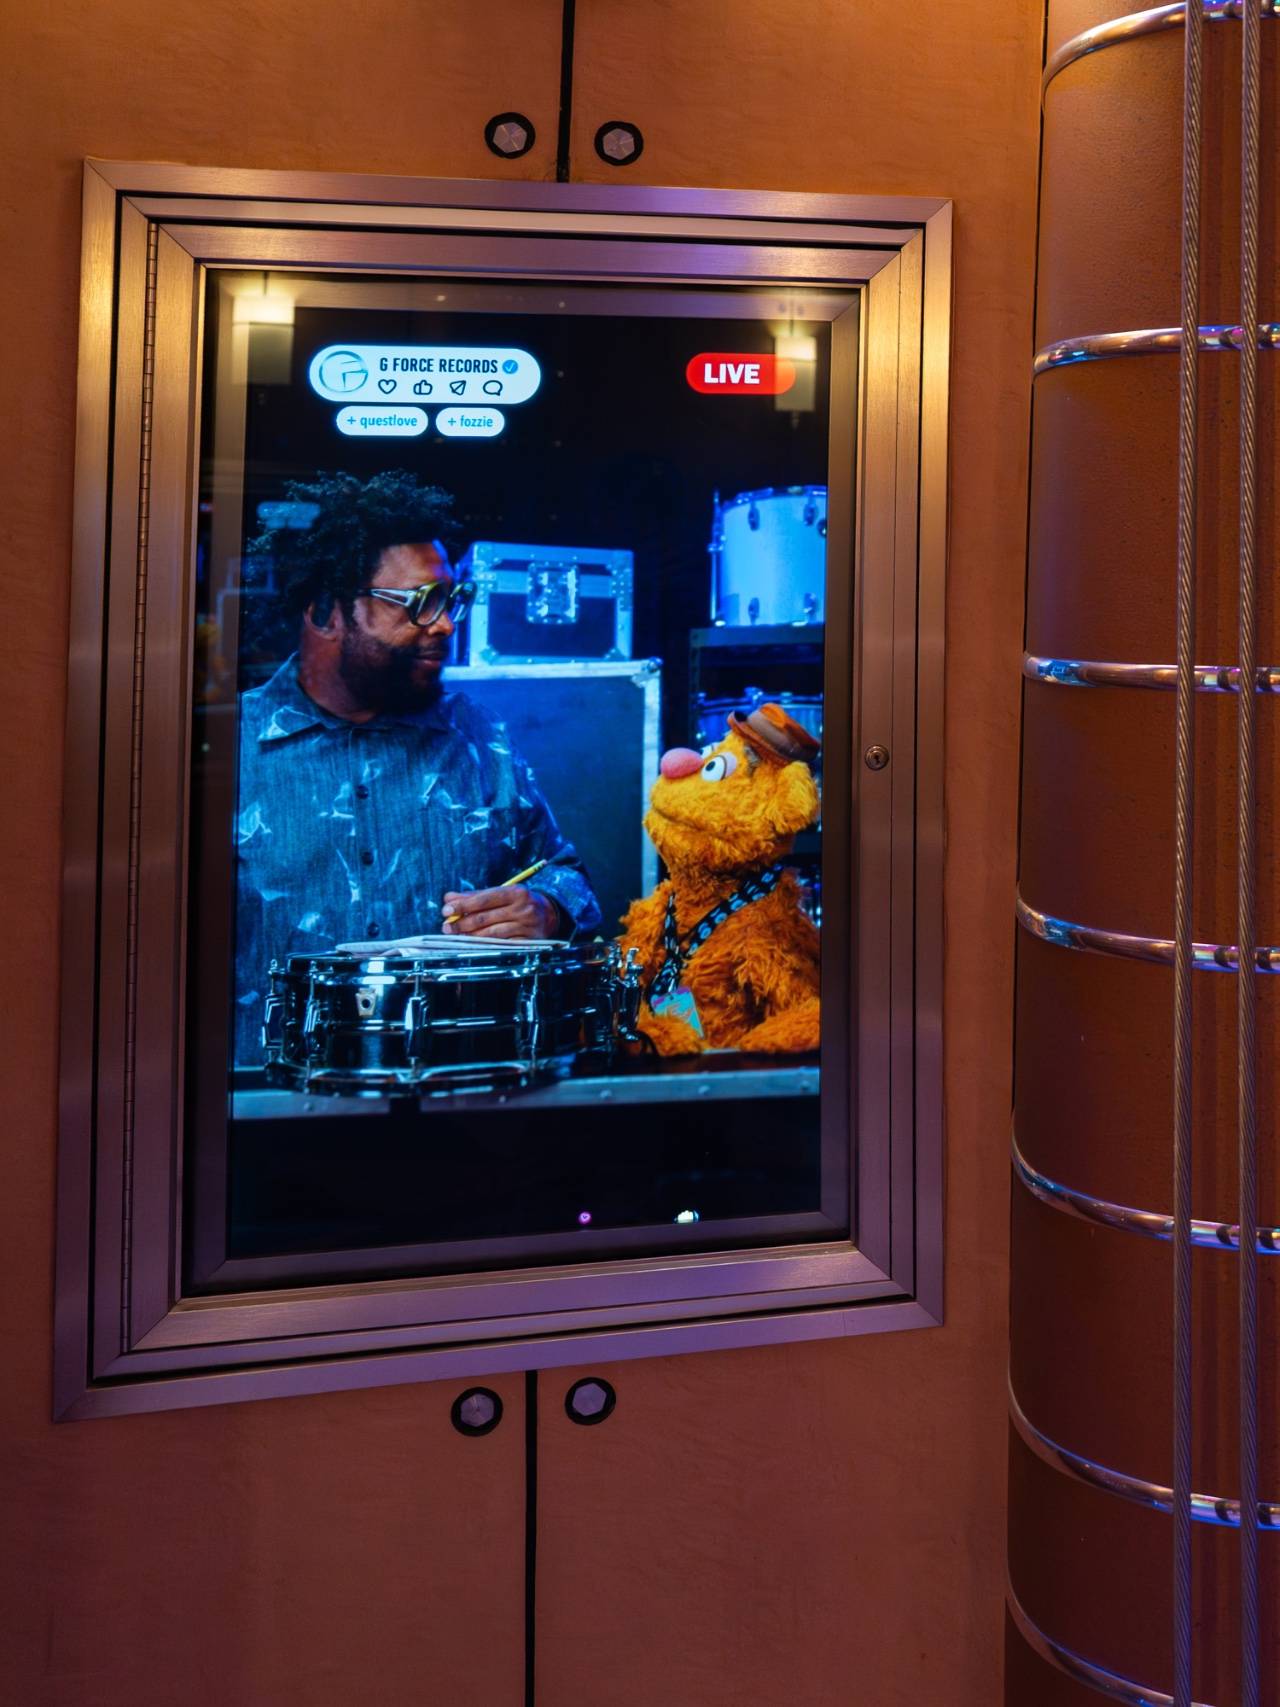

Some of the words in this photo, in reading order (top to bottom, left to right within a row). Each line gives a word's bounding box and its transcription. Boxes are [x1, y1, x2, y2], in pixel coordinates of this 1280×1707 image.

[380, 358, 388, 372] G
[393, 358, 434, 372] FORCE
[439, 359, 498, 373] RECORDS
[704, 363, 760, 384] LIVE
[360, 415, 417, 428] questlove
[460, 415, 493, 427] fozzie
